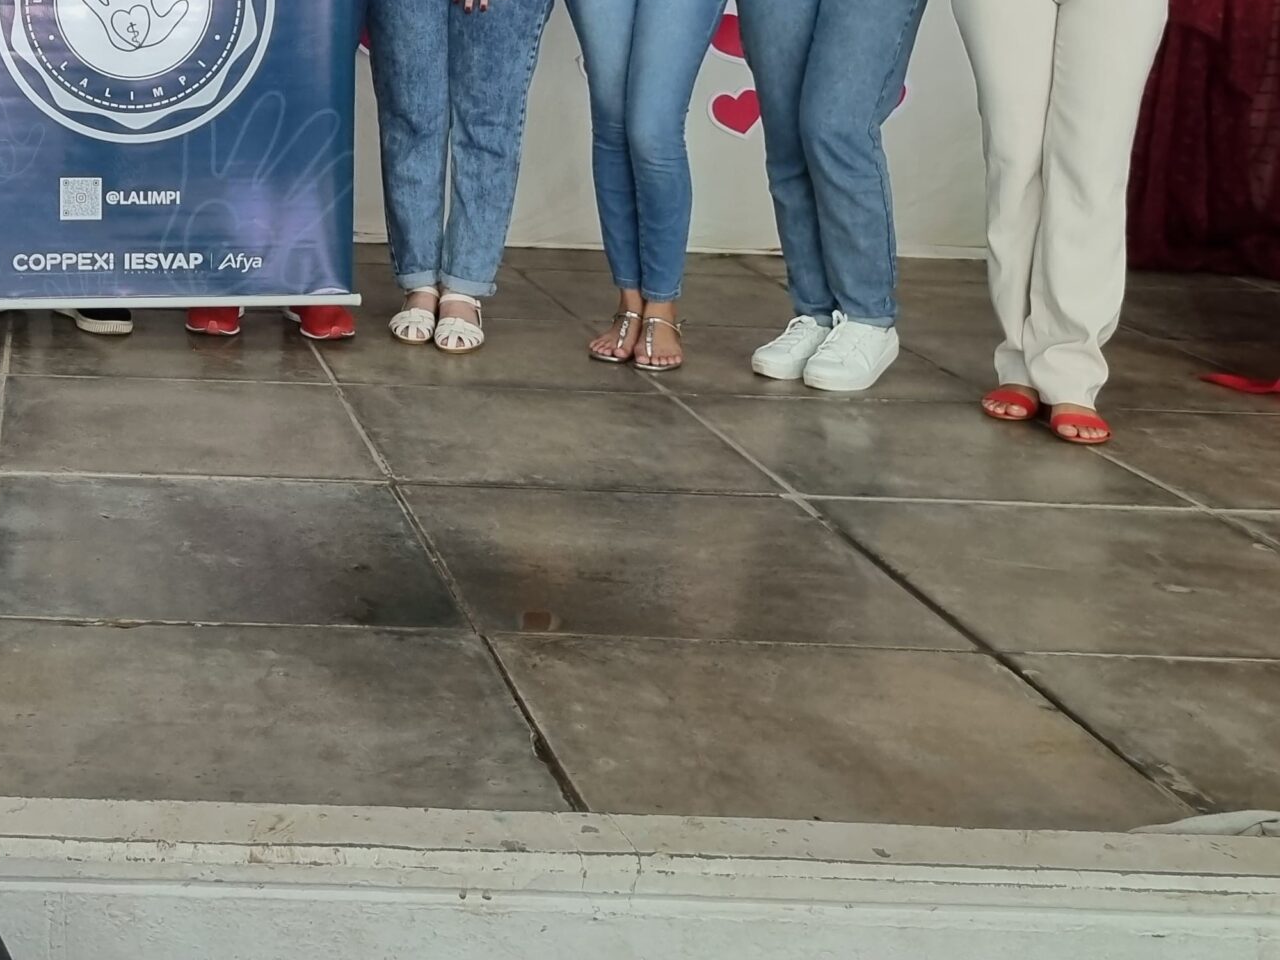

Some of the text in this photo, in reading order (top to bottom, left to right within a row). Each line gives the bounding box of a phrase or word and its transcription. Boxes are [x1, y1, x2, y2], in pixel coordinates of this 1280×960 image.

[105, 190, 181, 206] @LALIMPI
[12, 252, 263, 273] COPPEXI IESVAP Afya
